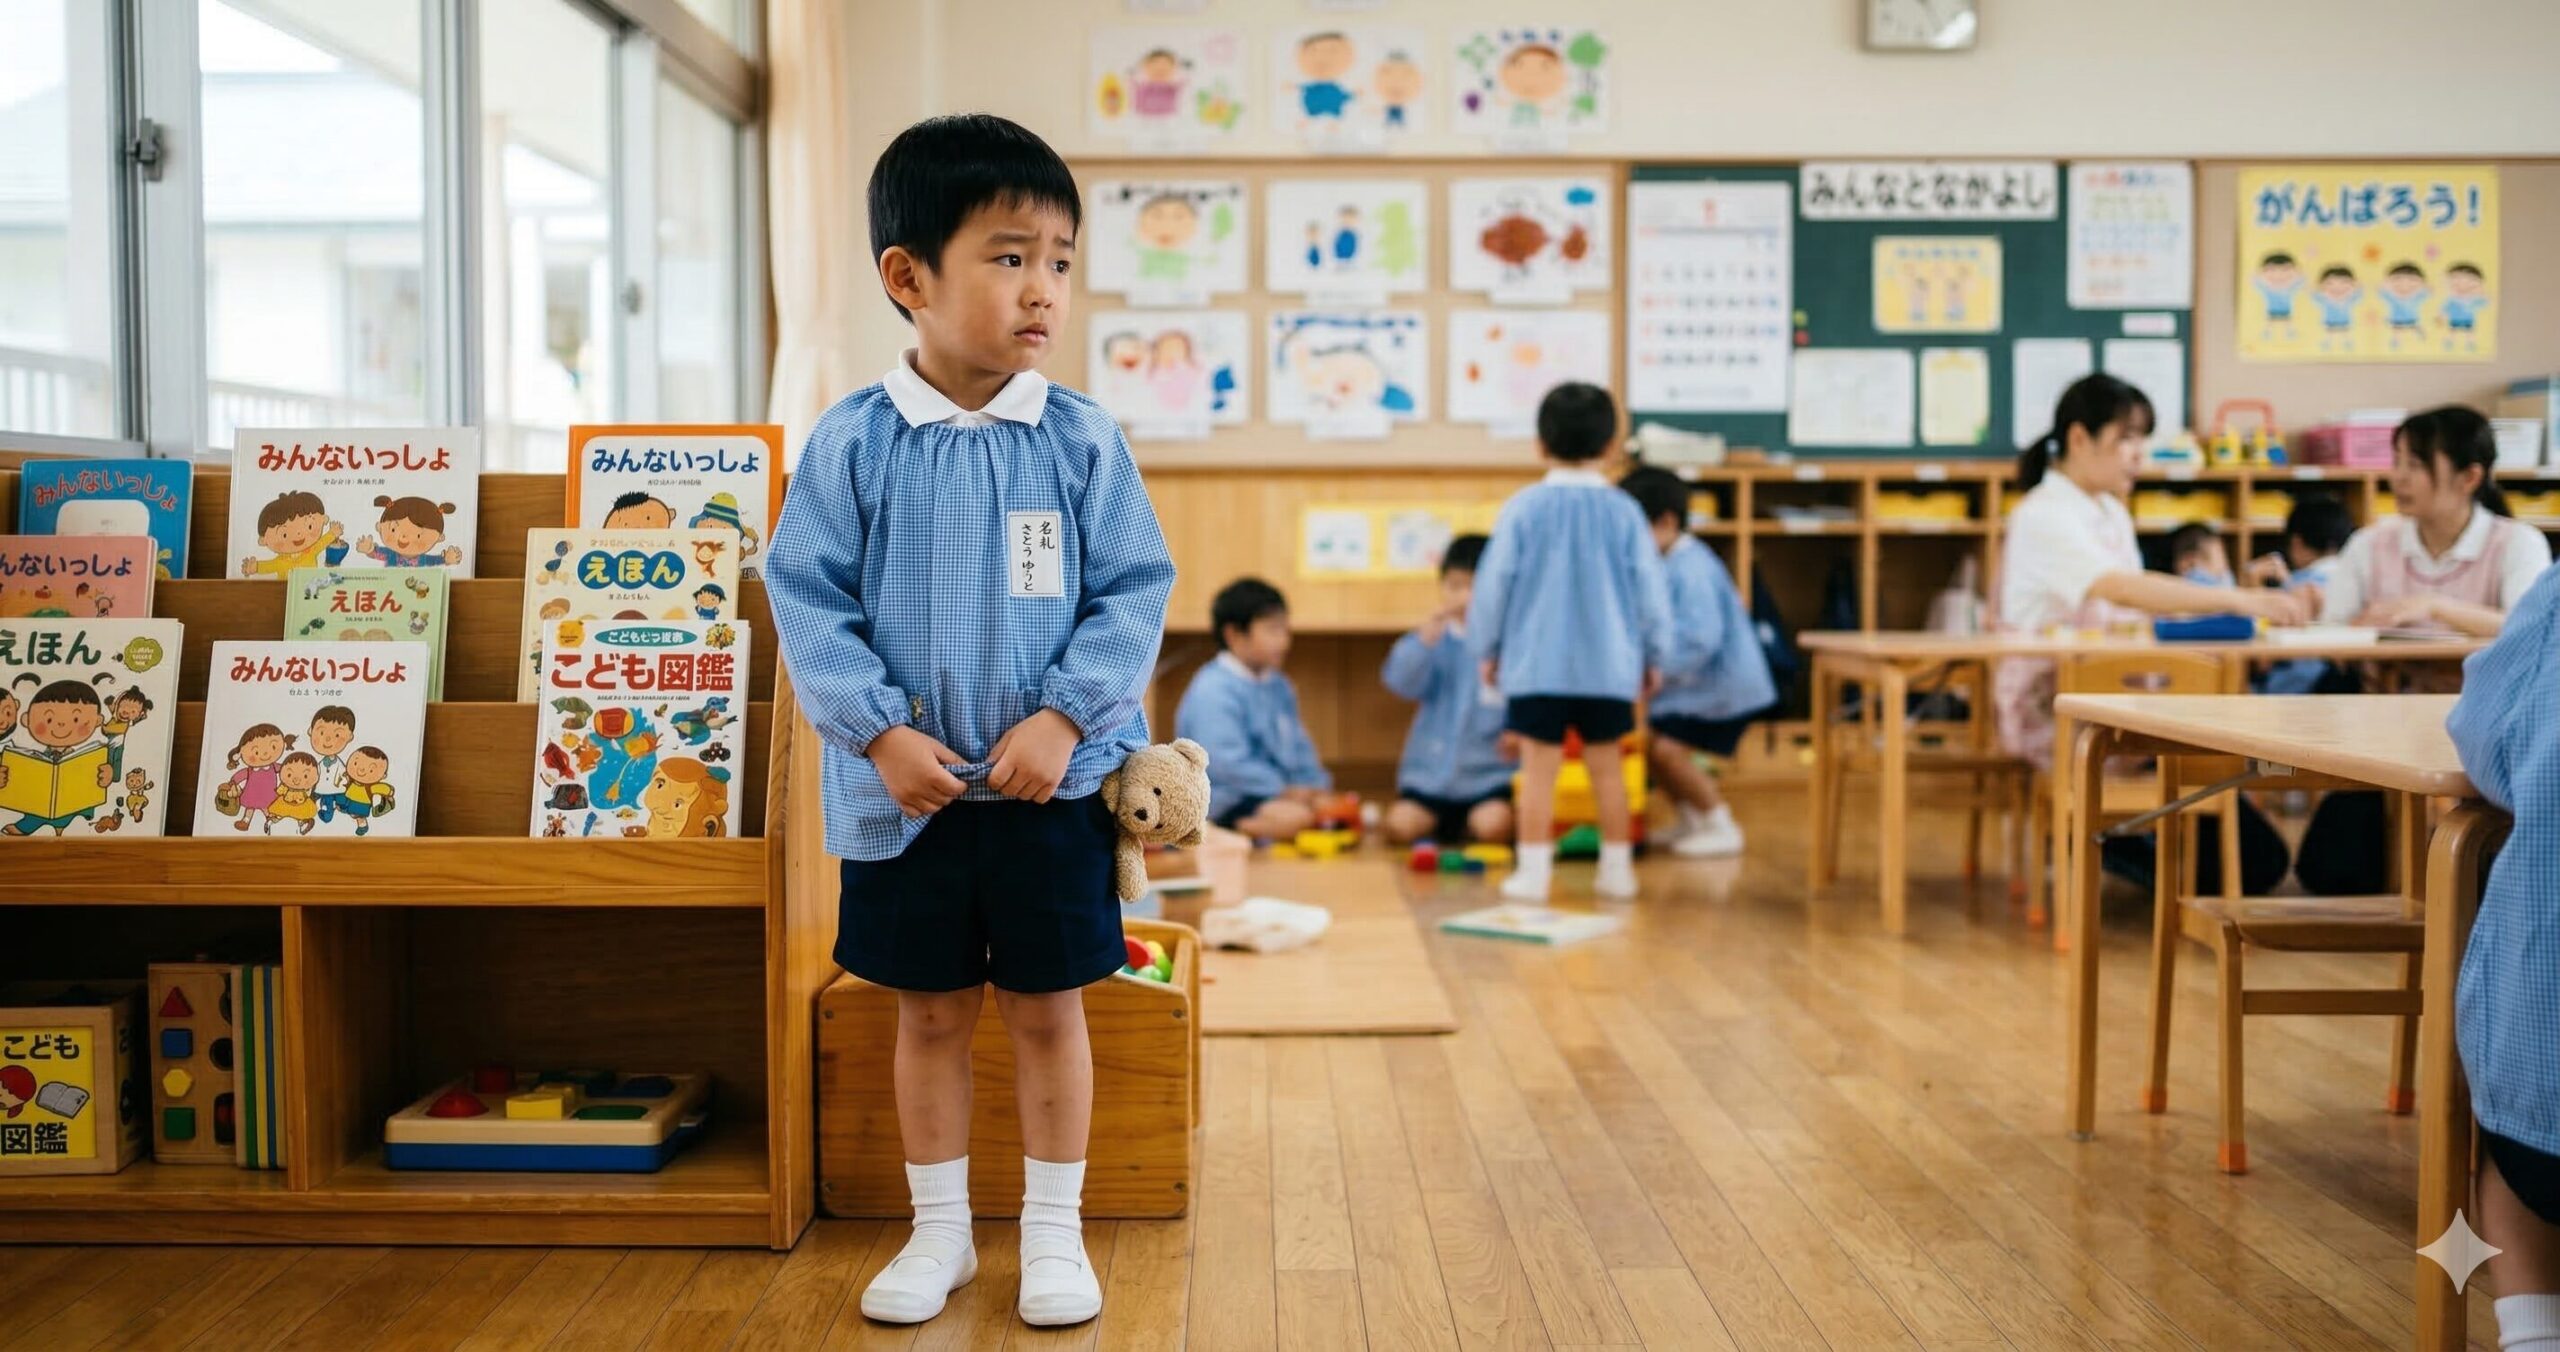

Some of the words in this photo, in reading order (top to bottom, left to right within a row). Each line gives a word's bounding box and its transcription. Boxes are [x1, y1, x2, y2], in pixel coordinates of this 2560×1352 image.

[258, 443, 451, 472] みんないっしょ
[592, 448, 759, 473] みんないっしょ
[34, 470, 177, 510] みんないっしょ
[1039, 521, 1055, 549] 名札
[583, 556, 679, 583] えほん
[330, 590, 402, 613] えほん
[0, 629, 101, 665] えほん
[231, 656, 406, 683] みんないっしょ
[551, 653, 734, 692] こども図鑑
[4, 1034, 79, 1060] こども
[1, 1122, 68, 1155] 図鑑
